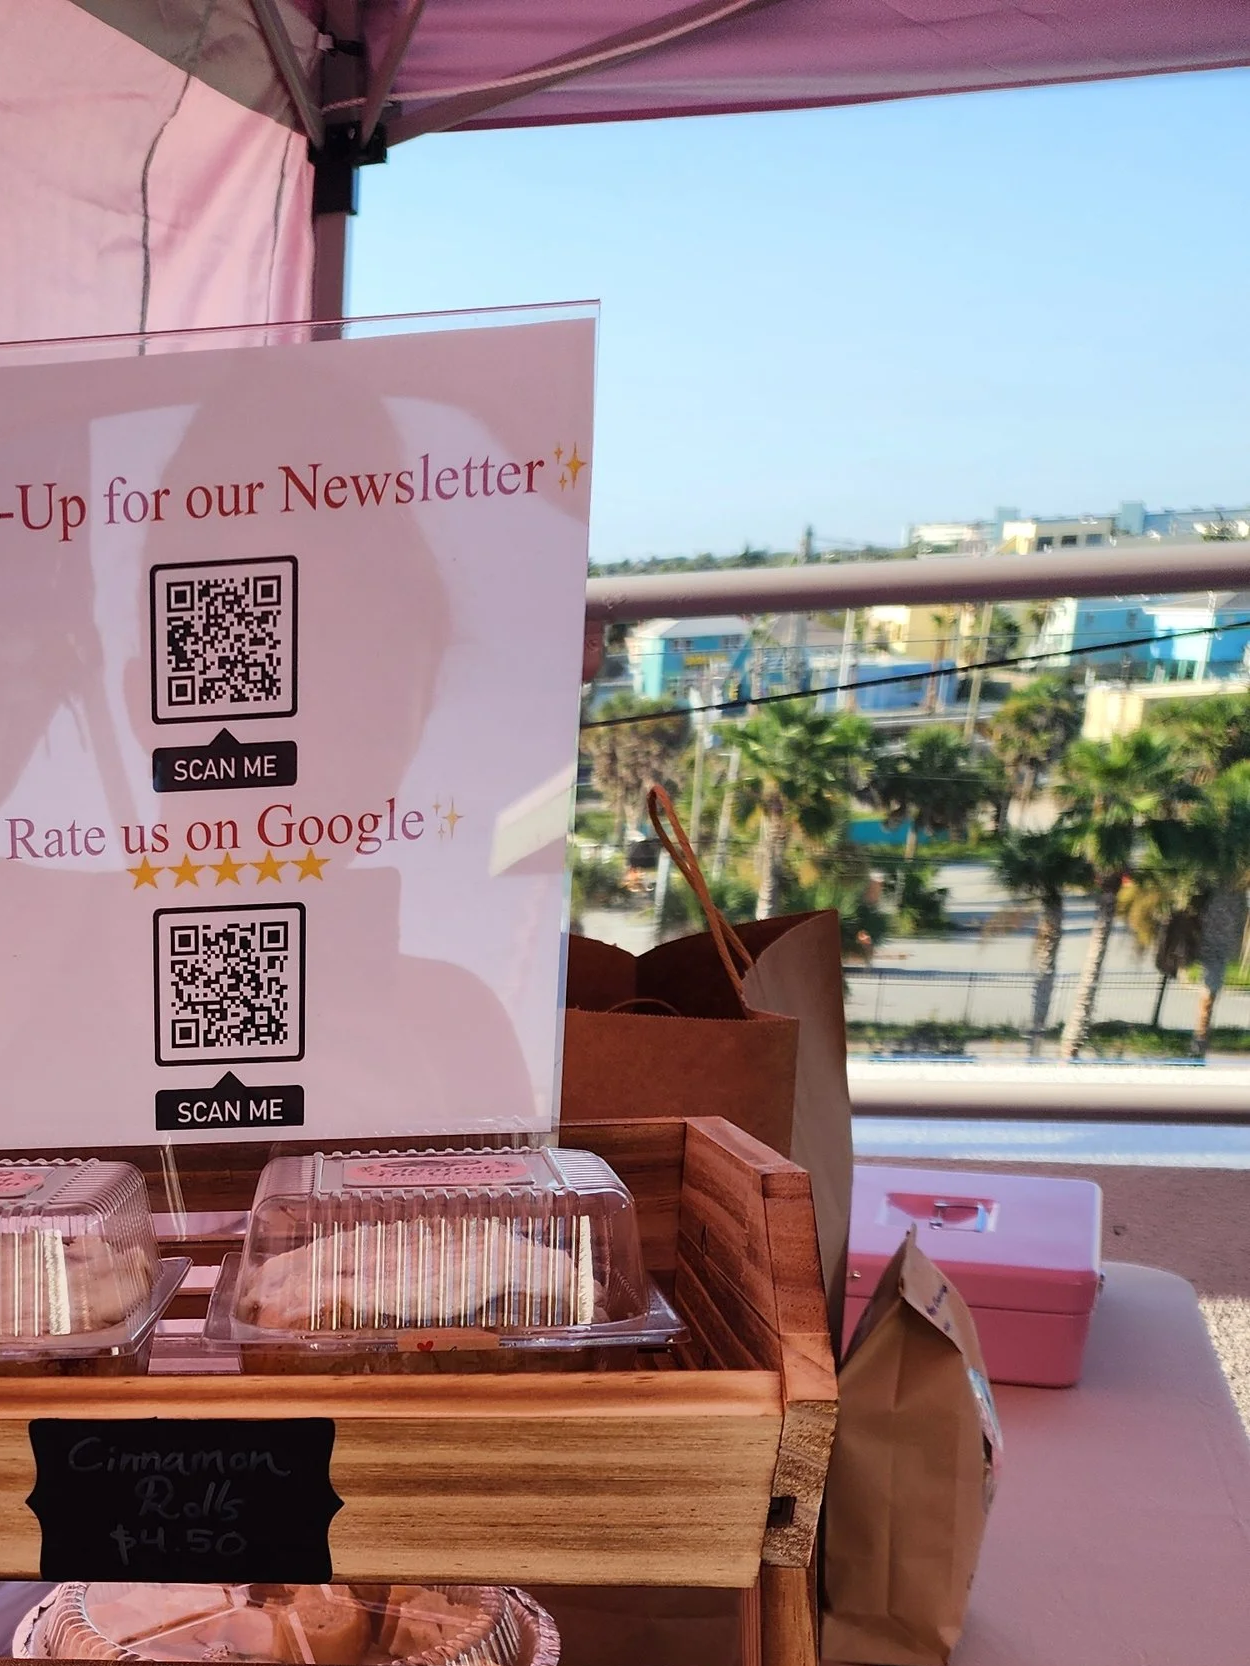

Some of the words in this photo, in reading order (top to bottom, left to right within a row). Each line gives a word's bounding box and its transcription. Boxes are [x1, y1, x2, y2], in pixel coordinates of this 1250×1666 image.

[103, 474, 170, 525] for
[185, 479, 264, 520] our
[279, 452, 546, 514] Newsletter
[173, 757, 236, 783] SCAN
[243, 753, 278, 779] ME
[4, 818, 107, 861] Rate
[121, 821, 170, 854] us
[186, 818, 242, 852] on
[255, 797, 426, 862] Google
[177, 1098, 241, 1124] SCAN
[249, 1097, 284, 1121] ME
[68, 1436, 292, 1477] Cinnamon
[134, 1474, 245, 1521] Rolls
[110, 1523, 248, 1566] $4.50
